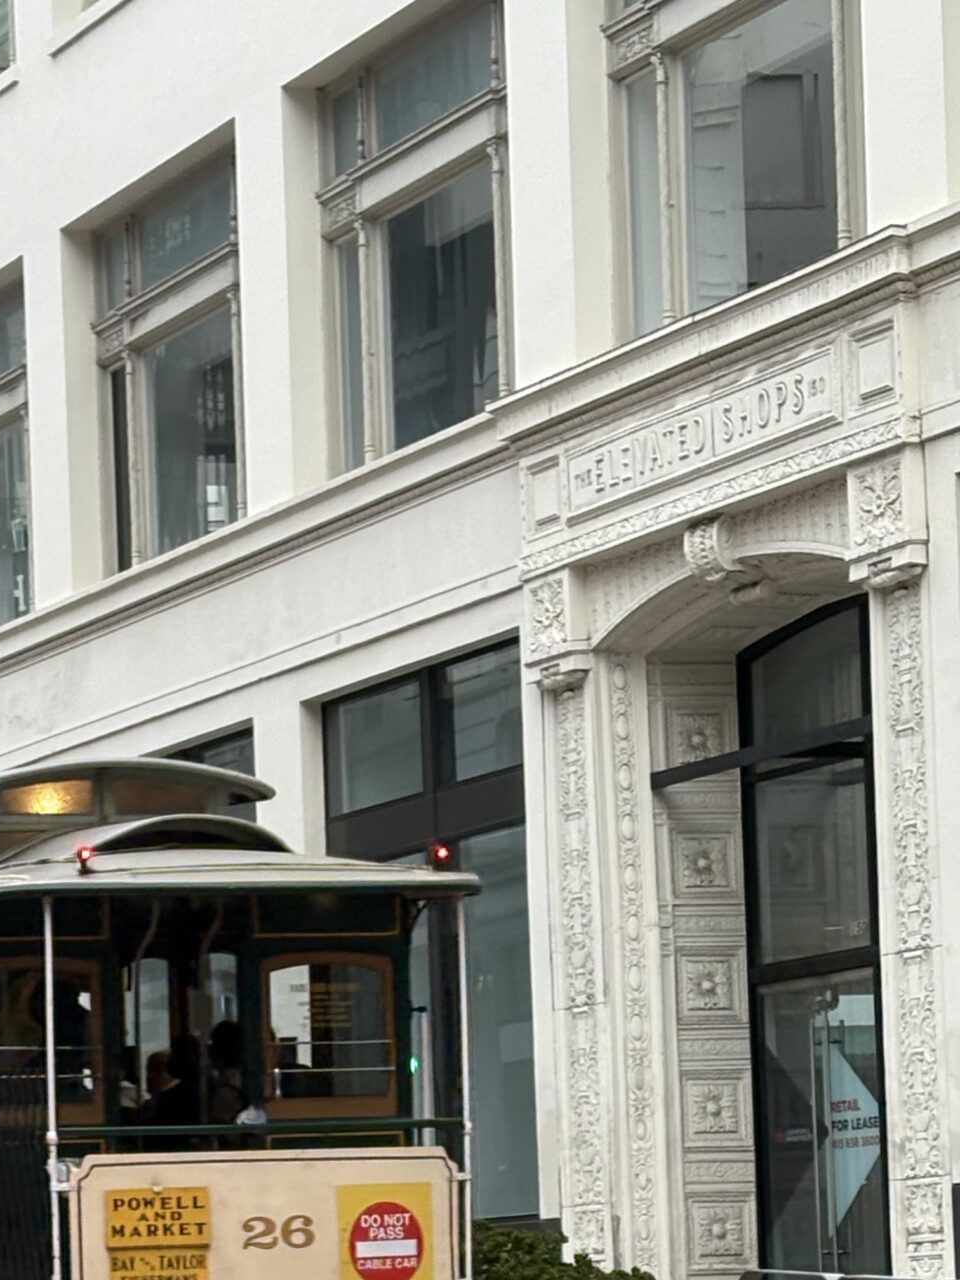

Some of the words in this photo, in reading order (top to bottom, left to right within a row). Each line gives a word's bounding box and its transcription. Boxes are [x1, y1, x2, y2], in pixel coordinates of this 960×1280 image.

[574, 469, 592, 491] THE
[595, 415, 706, 494] ELEVATED
[722, 373, 804, 443] SHOPS
[831, 1120, 848, 1132] FOR
[851, 1116, 880, 1130] LEASE
[113, 1196, 206, 1211] POWELL
[138, 1211, 183, 1222] AND
[361, 1214, 381, 1227] DO
[384, 1213, 411, 1226] NOT
[111, 1223, 207, 1238] MARKET
[242, 1215, 316, 1250] 26
[369, 1227, 404, 1239] PASS
[112, 1257, 135, 1272] BAY
[158, 1255, 207, 1270] TAYLOR
[357, 1259, 392, 1270] CABLE
[395, 1257, 418, 1268] CAR
